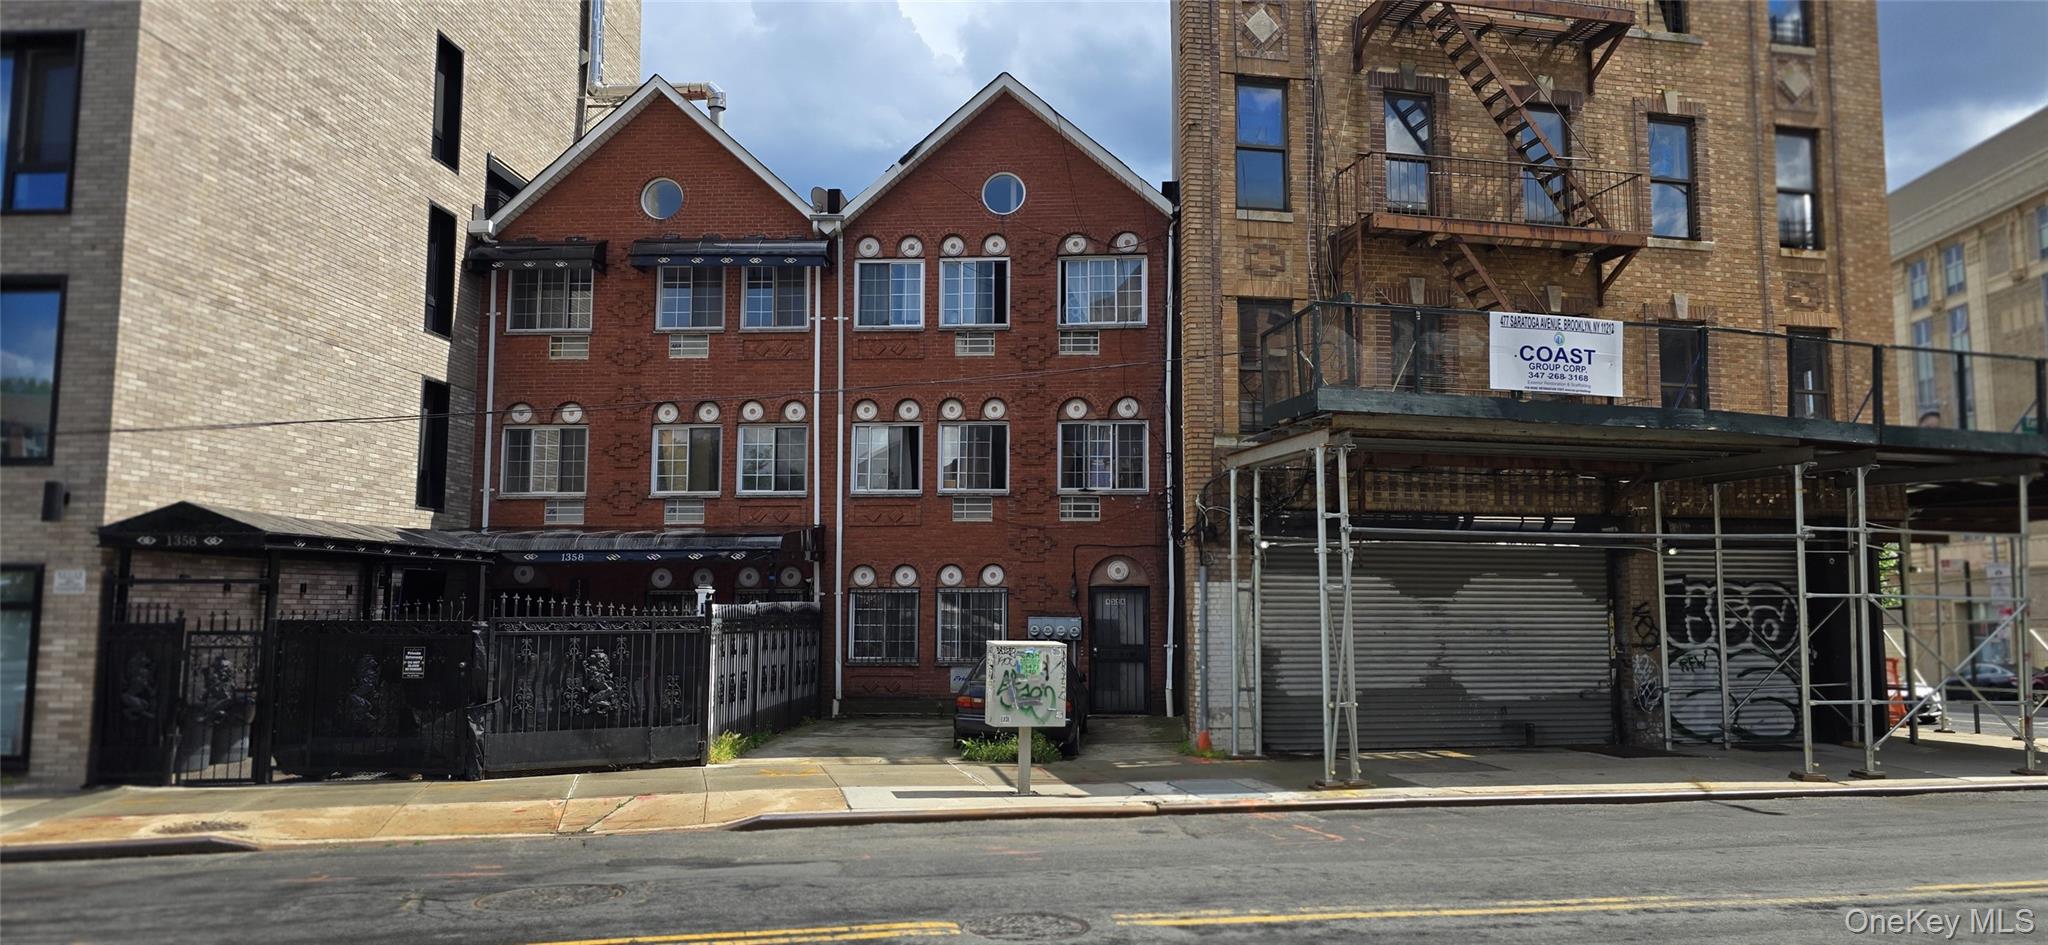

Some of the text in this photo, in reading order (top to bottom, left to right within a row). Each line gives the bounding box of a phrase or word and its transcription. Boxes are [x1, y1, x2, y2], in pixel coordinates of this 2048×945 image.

[1510, 315, 1539, 328] SARATOGA
[1593, 321, 1600, 332] NY
[1519, 345, 1596, 365] COAST
[1528, 362, 1588, 374] GROUP CORP.
[1528, 371, 1545, 379] 347
[1568, 373, 1589, 382] 3168
[166, 535, 197, 546] 1358
[561, 553, 585, 561] 1358
